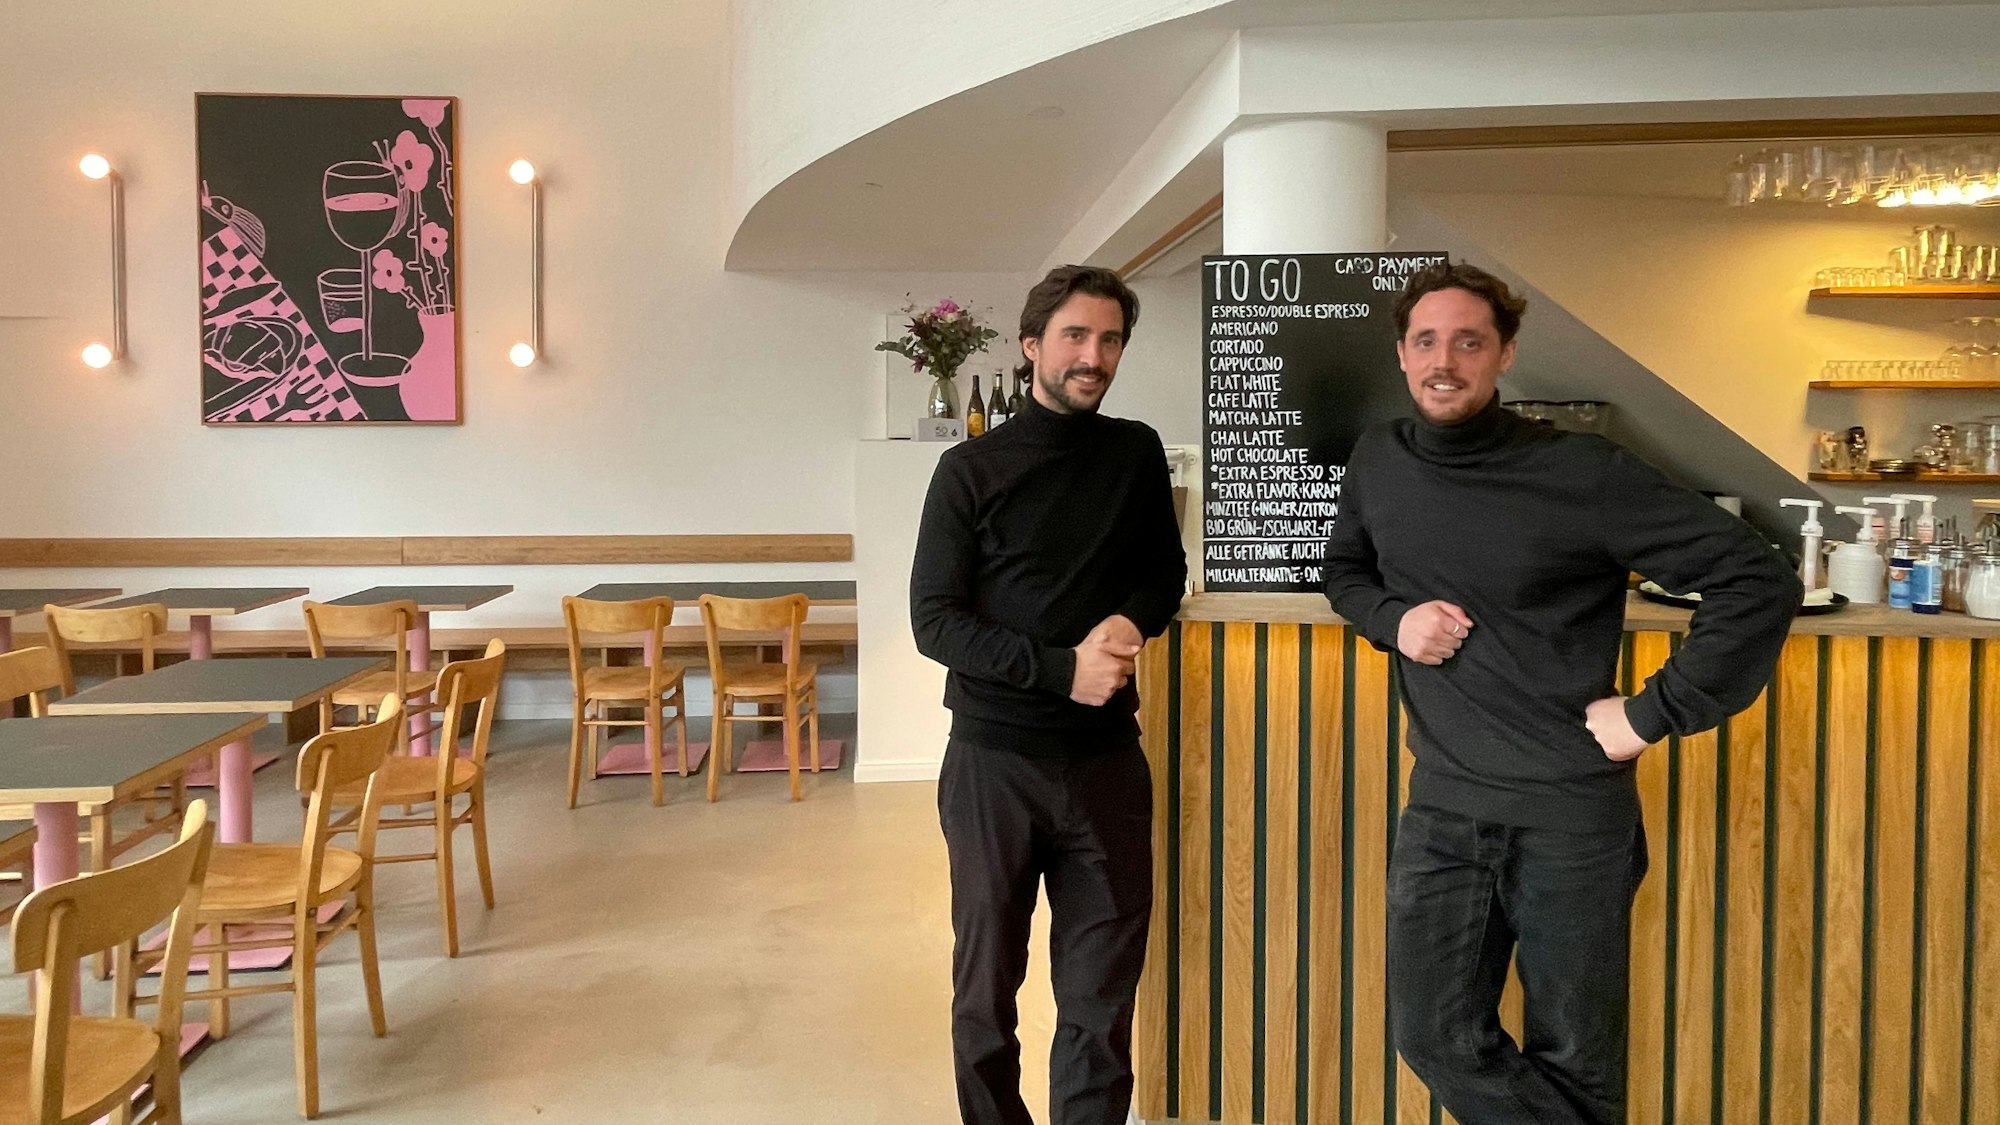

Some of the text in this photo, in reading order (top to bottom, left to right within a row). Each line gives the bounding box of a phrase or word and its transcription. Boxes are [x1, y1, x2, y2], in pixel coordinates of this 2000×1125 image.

[1204, 258, 1302, 303] TO GO
[1372, 275, 1409, 292] ONLY
[1314, 302, 1370, 319] ESPRESSO
[1209, 320, 1279, 337] AMERICANO
[1209, 338, 1265, 355] CORTADO
[1209, 356, 1284, 373] CAPPUCCINO
[1210, 373, 1282, 392] FLAT WHITE
[1208, 391, 1279, 410] CAFE LATTE
[1208, 409, 1303, 426] MATCHA LATTE
[1210, 429, 1285, 447] CHAI LATTE
[1210, 447, 1309, 464] HOT CHOCOLATE
[1259, 464, 1324, 482] ESPRESSO
[1205, 500, 1251, 518] MINZTEE
[1205, 518, 1226, 536] BIO
[1205, 544, 1233, 561] ALLE
[1233, 541, 1290, 561] GETRÄNKE
[1291, 542, 1320, 560] AUCH
